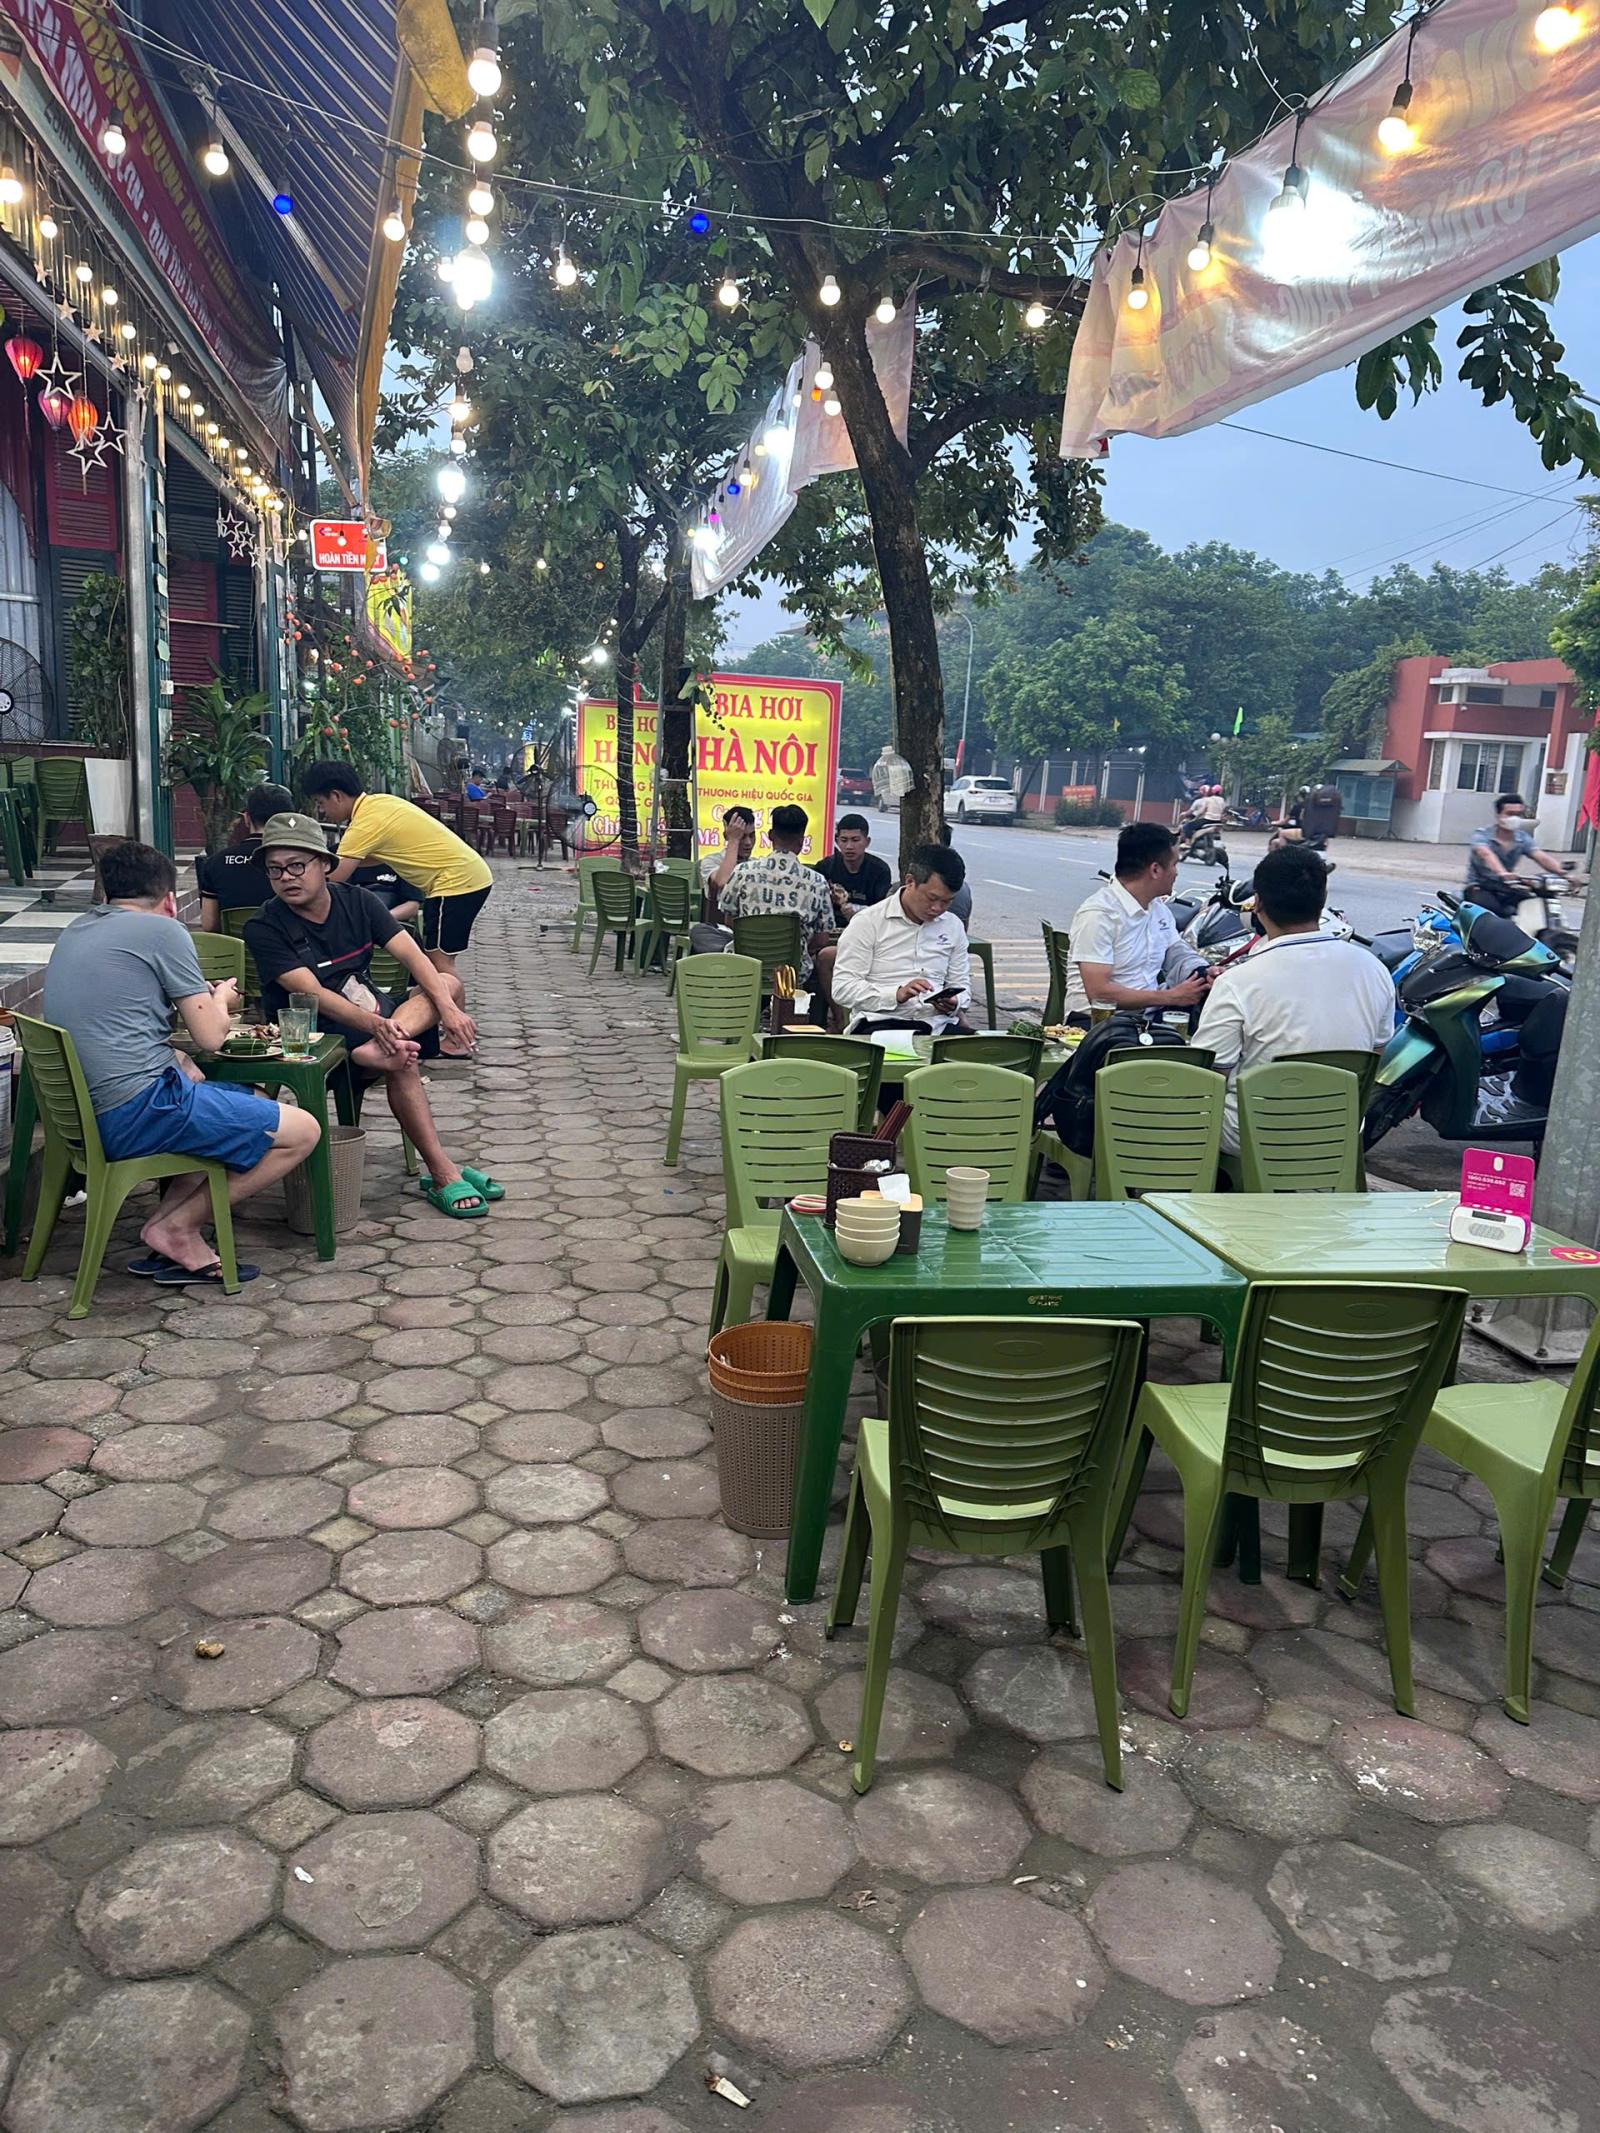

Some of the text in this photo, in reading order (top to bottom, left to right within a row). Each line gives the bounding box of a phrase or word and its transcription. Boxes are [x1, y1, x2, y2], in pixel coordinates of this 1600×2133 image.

[319, 551, 340, 564] HOÀN
[715, 693, 803, 721] BIA HƠI
[697, 728, 747, 773] HÀ
[753, 733, 818, 785] NỘI
[796, 793, 813, 801] GIA
